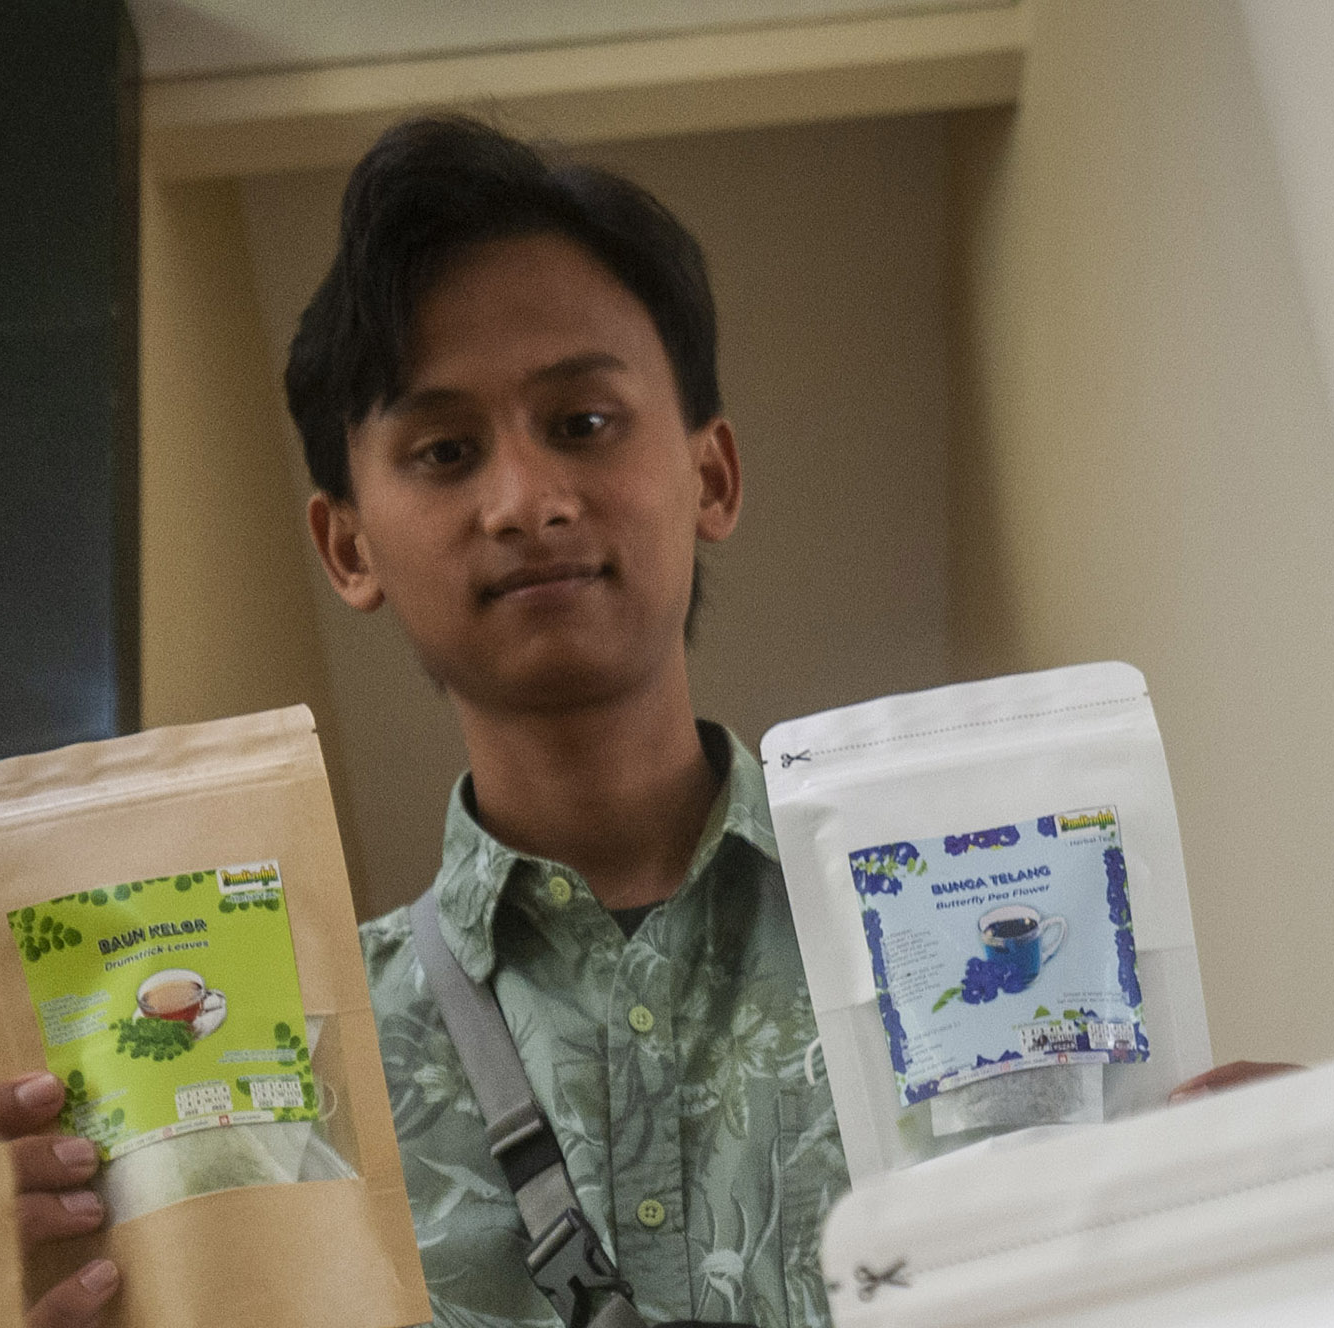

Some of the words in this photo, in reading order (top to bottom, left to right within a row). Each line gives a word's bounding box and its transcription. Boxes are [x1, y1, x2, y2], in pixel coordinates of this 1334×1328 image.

[931, 877, 988, 896] BUNGA
[988, 865, 1052, 887] TELANG
[935, 895, 986, 911] Butterfly
[987, 891, 1010, 902] Pea
[1012, 883, 1051, 899] Flower
[148, 918, 208, 940] KELOR
[104, 944, 165, 973] Drumstick
[166, 939, 210, 953] Leaves
